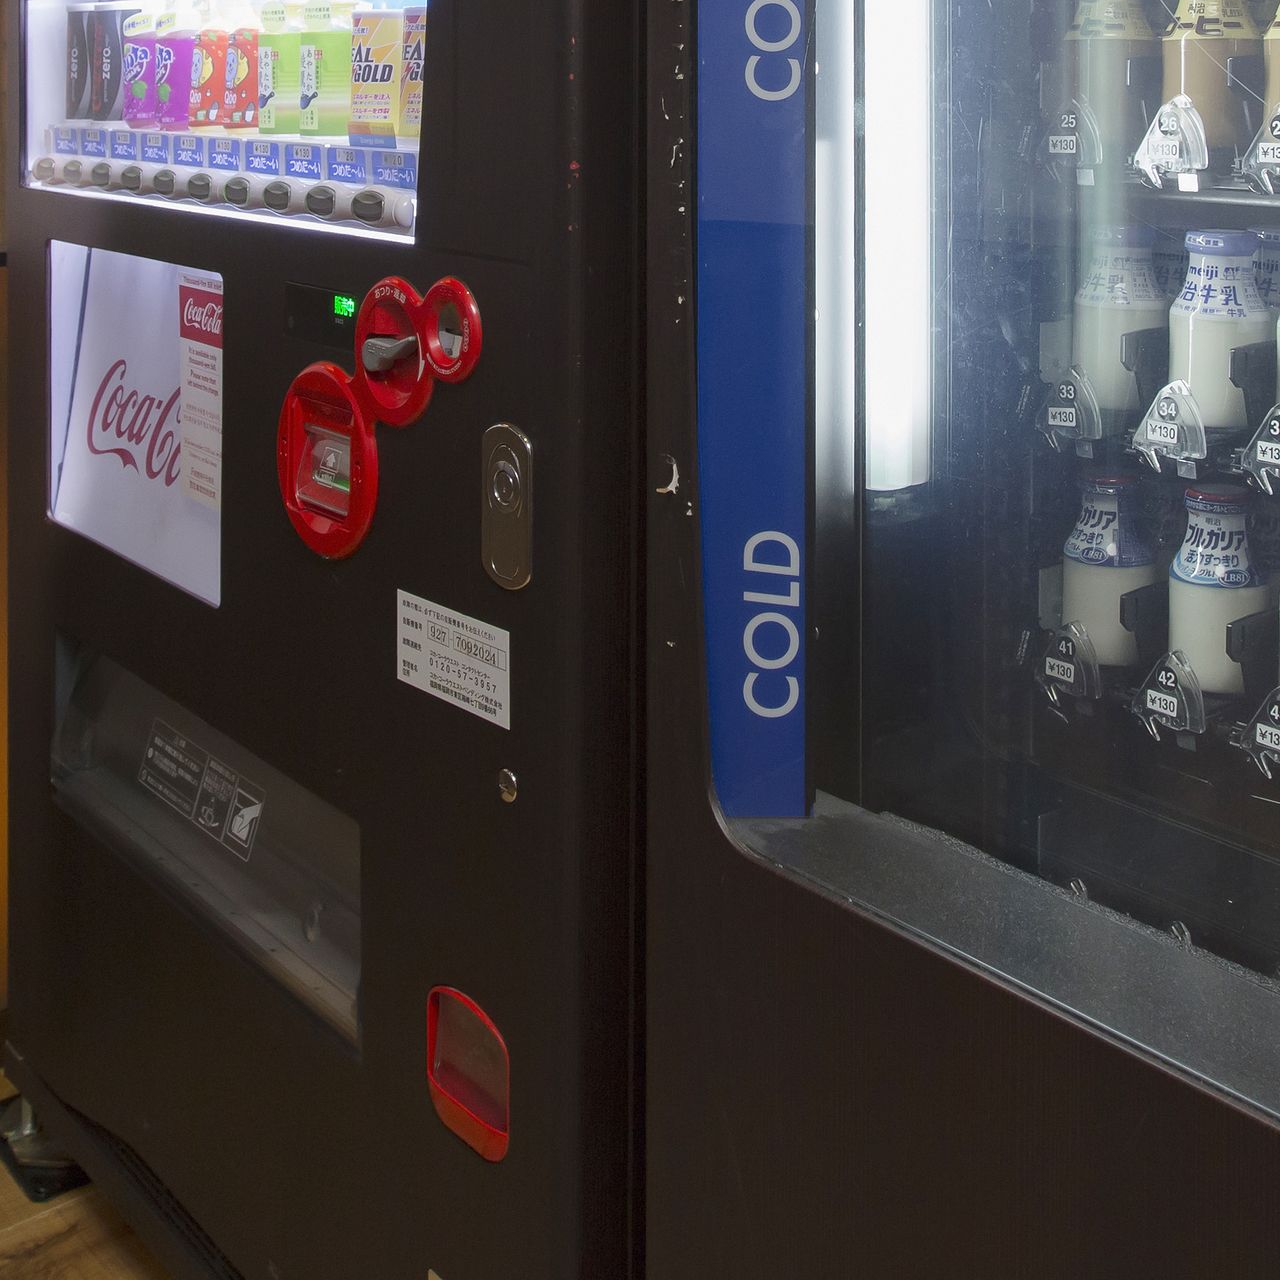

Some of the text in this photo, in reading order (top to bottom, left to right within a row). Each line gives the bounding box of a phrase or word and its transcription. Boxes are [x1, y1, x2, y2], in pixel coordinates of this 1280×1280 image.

[70, 49, 79, 81] zero
[103, 49, 112, 81] zero
[354, 64, 394, 84] GOLD
[1189, 266, 1219, 280] meiji
[333, 295, 356, 318] 販売中
[1059, 385, 1074, 400] 33
[1051, 410, 1074, 424] ¥130
[1160, 402, 1178, 418] 34
[1150, 424, 1176, 440] ¥130
[1187, 521, 1247, 552] ブルガリア
[1185, 550, 1239, 569] 活力すっきり
[743, 531, 800, 719] COLD
[429, 624, 497, 666] 927 7092024
[1059, 640, 1074, 656] 41
[429, 656, 497, 695] 0120-57-3957
[1047, 662, 1073, 680] ¥130
[1159, 671, 1176, 687] 42
[1149, 695, 1176, 713] ¥130
